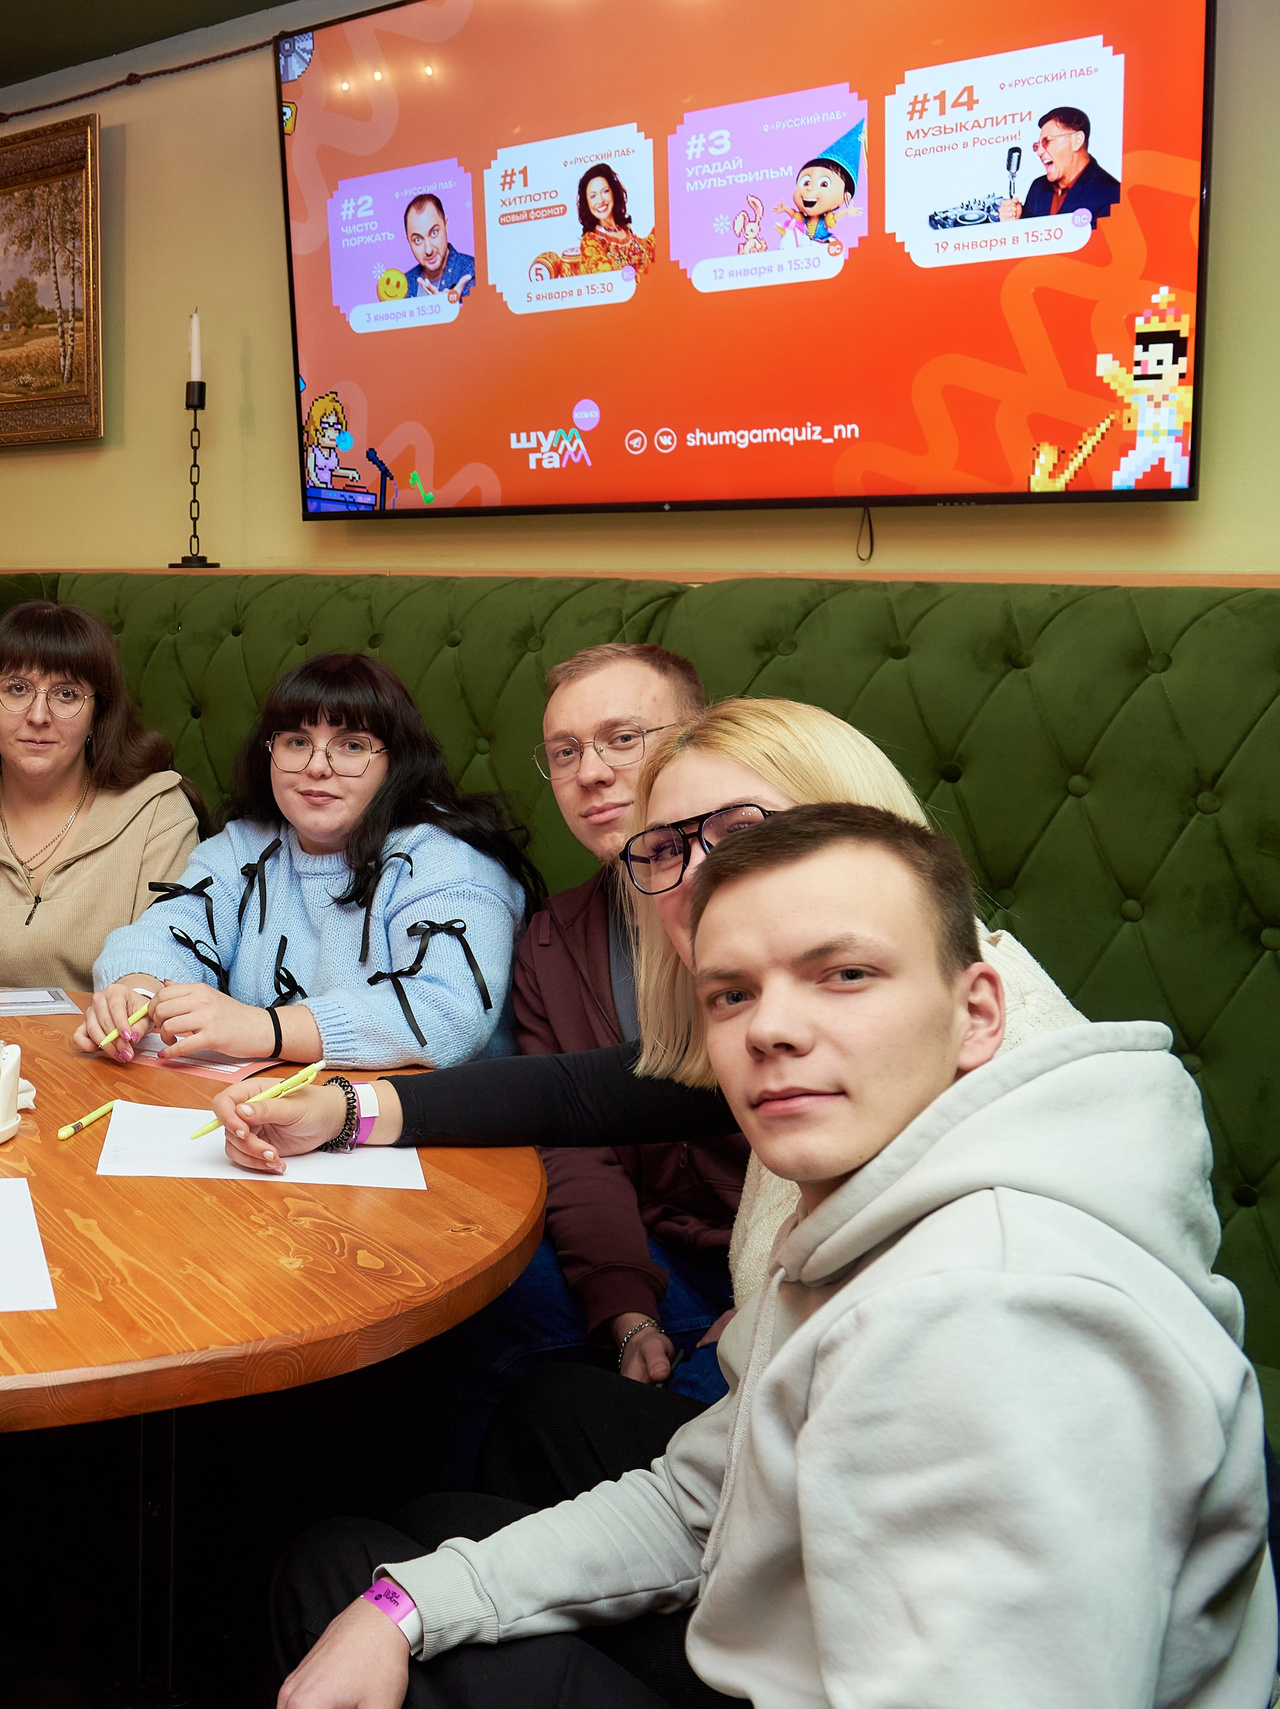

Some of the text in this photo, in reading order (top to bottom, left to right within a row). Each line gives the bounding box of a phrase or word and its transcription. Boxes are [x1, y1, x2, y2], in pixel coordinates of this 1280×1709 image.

[1008, 66, 1099, 89] «РУССКИЙ ПАБ»
[907, 85, 979, 121] #14
[771, 110, 847, 130] «РУССКИЙ ПАБ»
[906, 110, 1032, 141] МУЗЫКАЛИТИ
[686, 129, 732, 160] #3
[905, 130, 1021, 158] Сделано в России!
[570, 147, 635, 165] «РУССКИЙ ПАБ»
[686, 156, 743, 177] УГАДАЙ
[500, 166, 529, 191] #1
[686, 165, 793, 192] МУЛЬТФИЛЬМ
[341, 195, 374, 221] #2
[500, 189, 558, 208] ХИТЛОТО
[500, 205, 564, 223] новый формат
[341, 221, 378, 235] ЧИСТО
[342, 231, 395, 248] ПОРЖАТЬ
[935, 227, 1064, 253] 19 января в 15:30
[713, 268, 725, 280] 12
[728, 265, 773, 280] января
[788, 257, 820, 271] 15:30
[527, 293, 532, 302] 5
[535, 290, 573, 303] января
[586, 282, 613, 295] 15:30
[366, 313, 371, 322] 3
[374, 311, 406, 323] января
[417, 304, 441, 316] 15:30
[686, 422, 860, 448] shumgamquiz_nn
